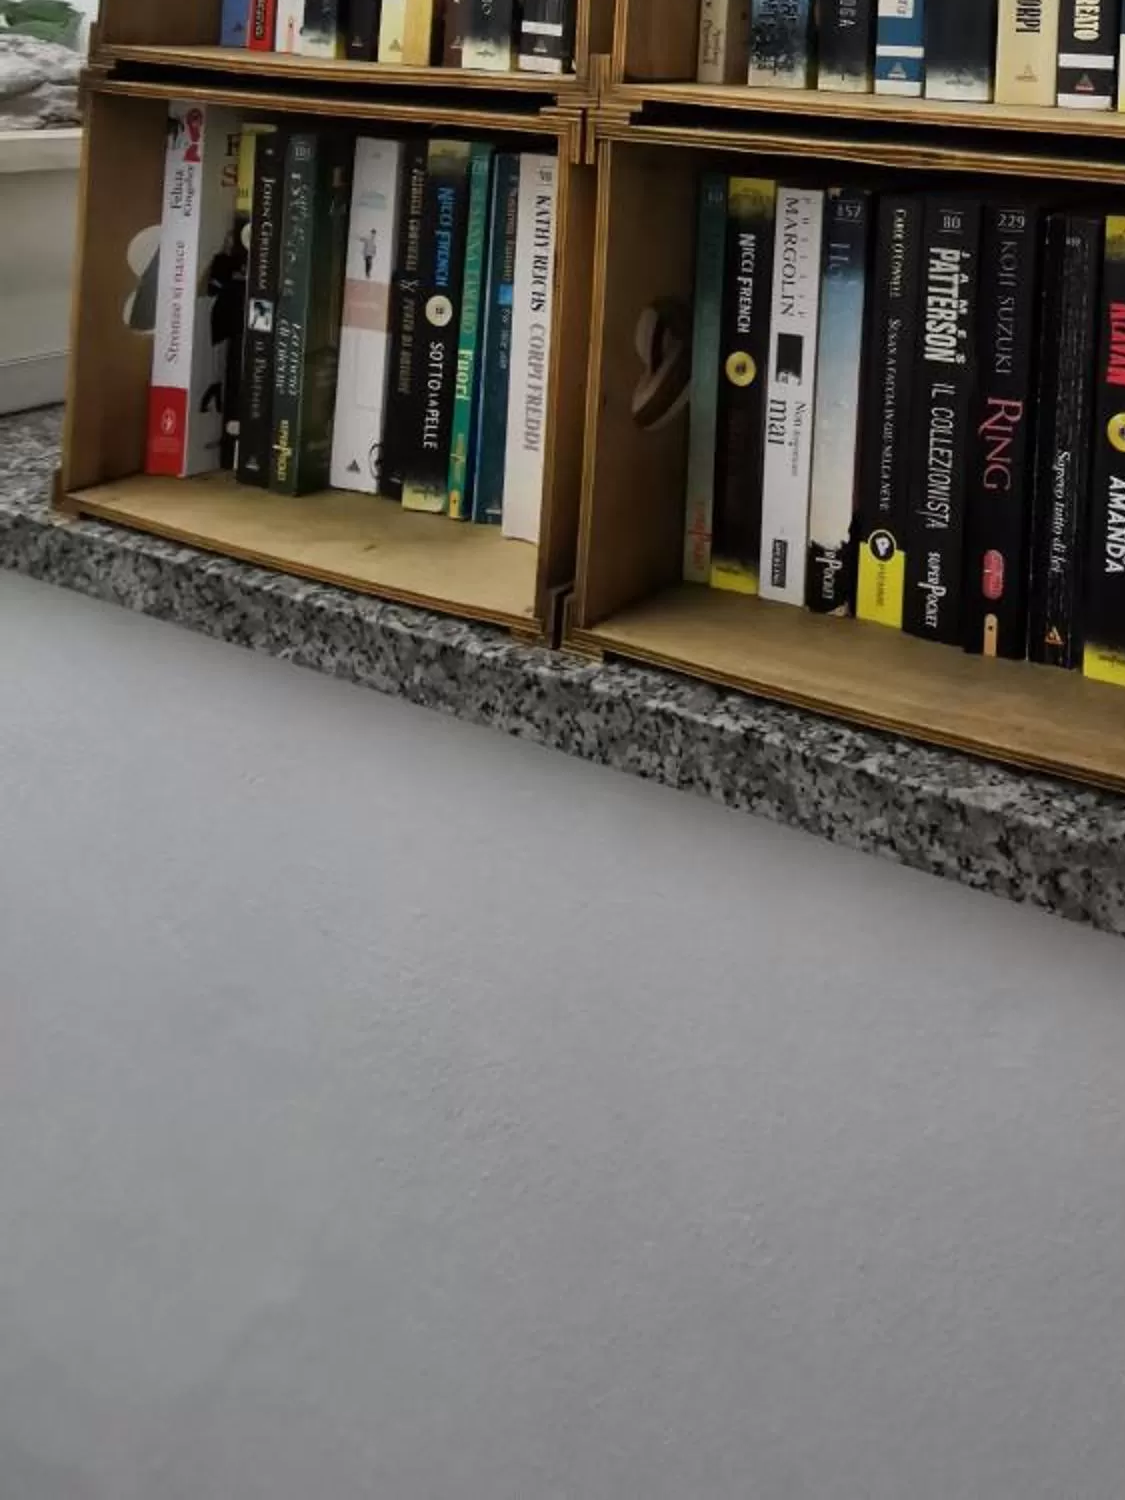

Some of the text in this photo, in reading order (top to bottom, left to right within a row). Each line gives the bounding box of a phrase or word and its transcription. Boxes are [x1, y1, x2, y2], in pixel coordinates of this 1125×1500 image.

[168, 169, 185, 211] Felicia
[998, 212, 1025, 228] 229
[165, 241, 185, 365] Stronze si nasce
[736, 233, 757, 333] NICCI FRENCH
[779, 196, 801, 318] MARGOLIN
[923, 247, 961, 363] PATTERSON
[522, 194, 552, 453] KATHY REICHS CORPI FREDDI
[994, 294, 1016, 375] SUZUKI
[422, 342, 444, 449] SOTTO LA PELLE
[455, 348, 474, 402] Fuori
[767, 399, 790, 445] mai
[792, 400, 807, 428] Non
[914, 382, 956, 530] IL COLLEZIONISTA
[977, 396, 1024, 492] RING
[1050, 449, 1072, 573] Sapevo tutto di lei
